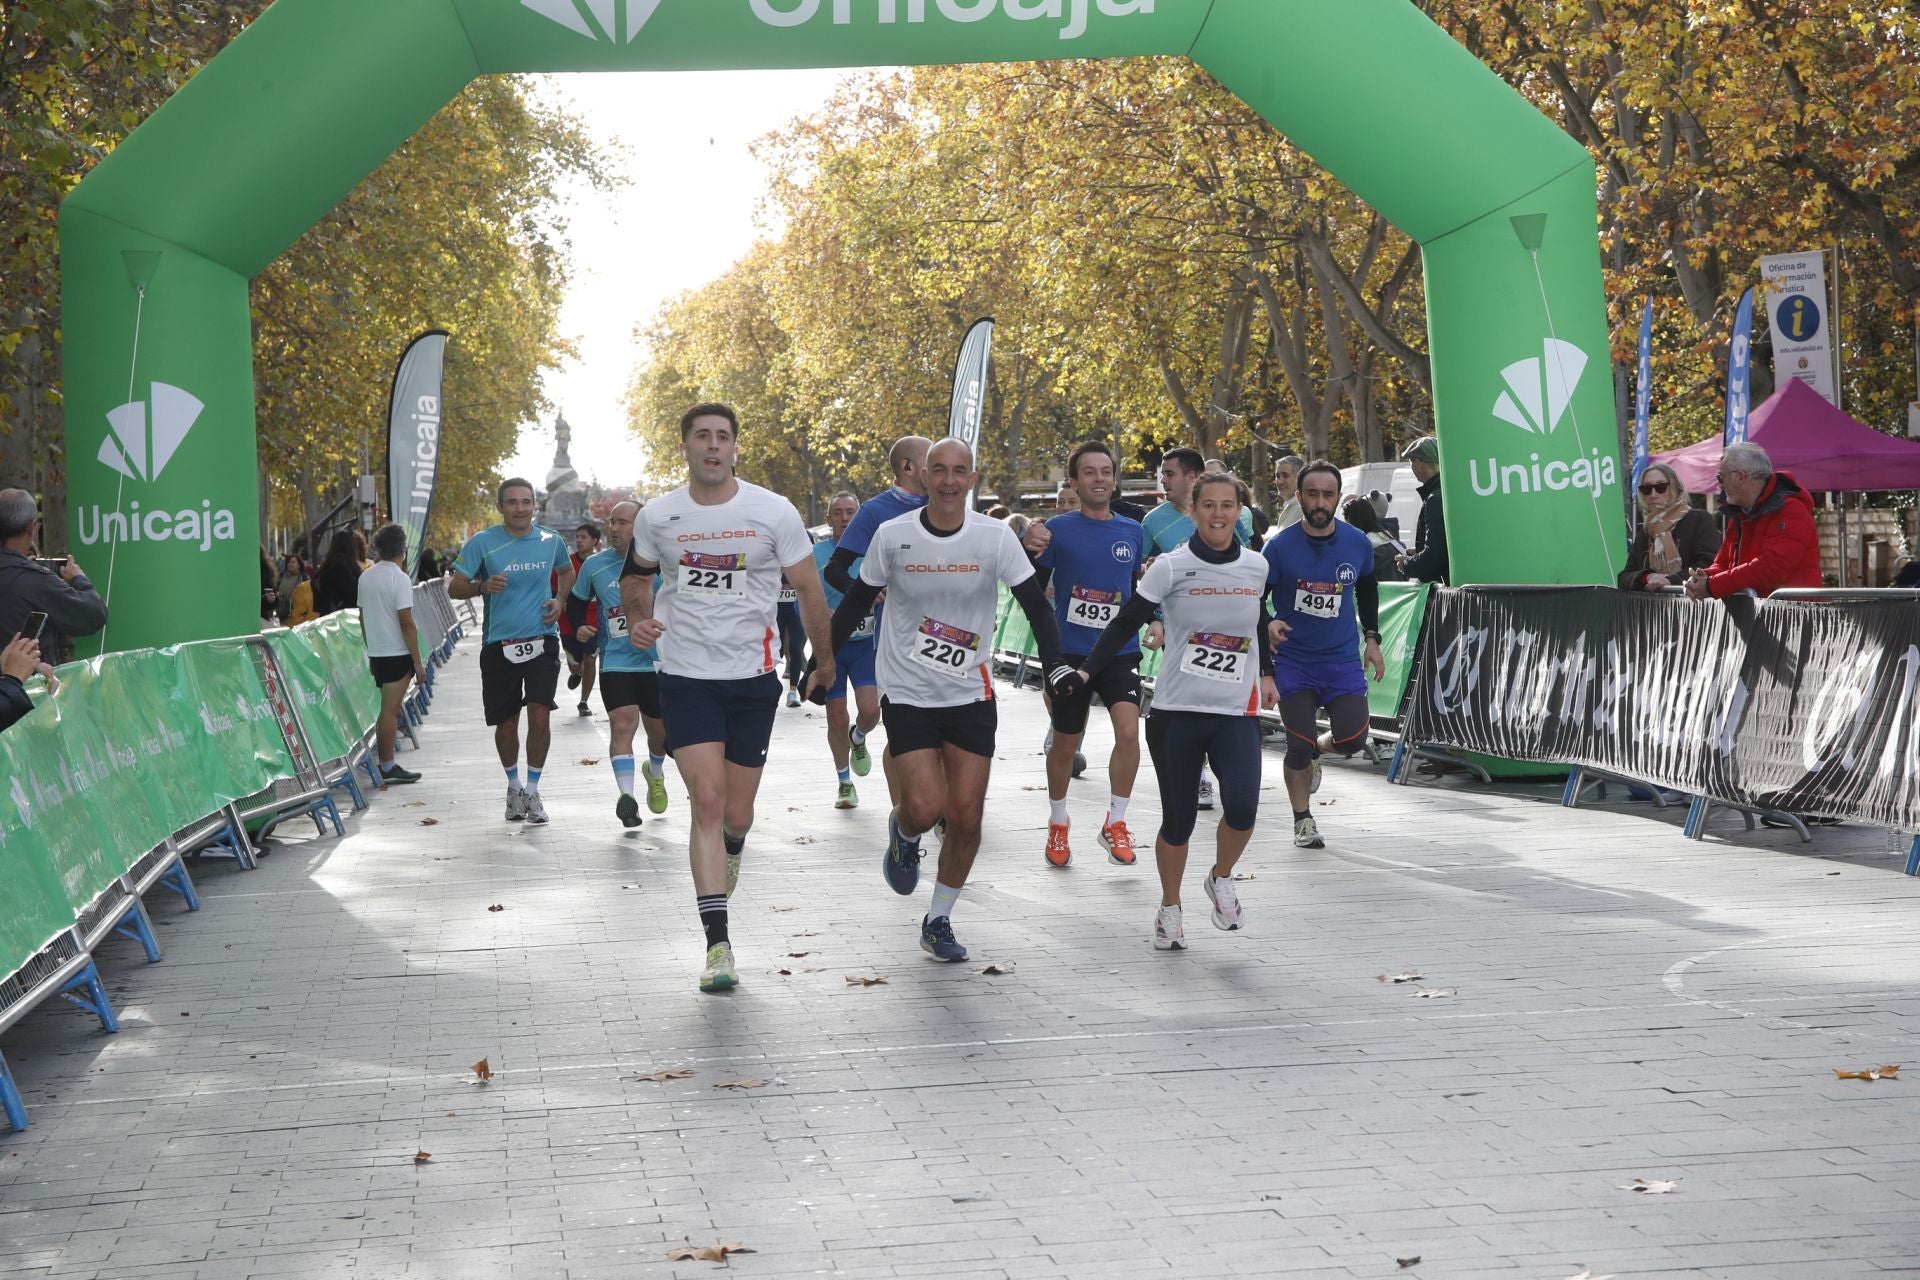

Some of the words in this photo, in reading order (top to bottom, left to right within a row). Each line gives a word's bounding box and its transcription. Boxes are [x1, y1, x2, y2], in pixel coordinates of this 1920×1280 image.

[1768, 263, 1795, 273] Oficina
[1797, 261, 1807, 270] de
[1470, 447, 1616, 498] Unicaja
[78, 499, 235, 552] Unicaja
[677, 530, 757, 542] COLLOSA
[503, 559, 547, 572] ADIENT
[904, 564, 980, 573] COLLOSA
[687, 569, 733, 590] 221
[1188, 587, 1259, 596] COLLOSA
[1302, 593, 1335, 611] 494
[1074, 602, 1111, 622] 493
[514, 643, 534, 657] 39
[920, 638, 965, 668] 220
[1191, 647, 1237, 673] 222
